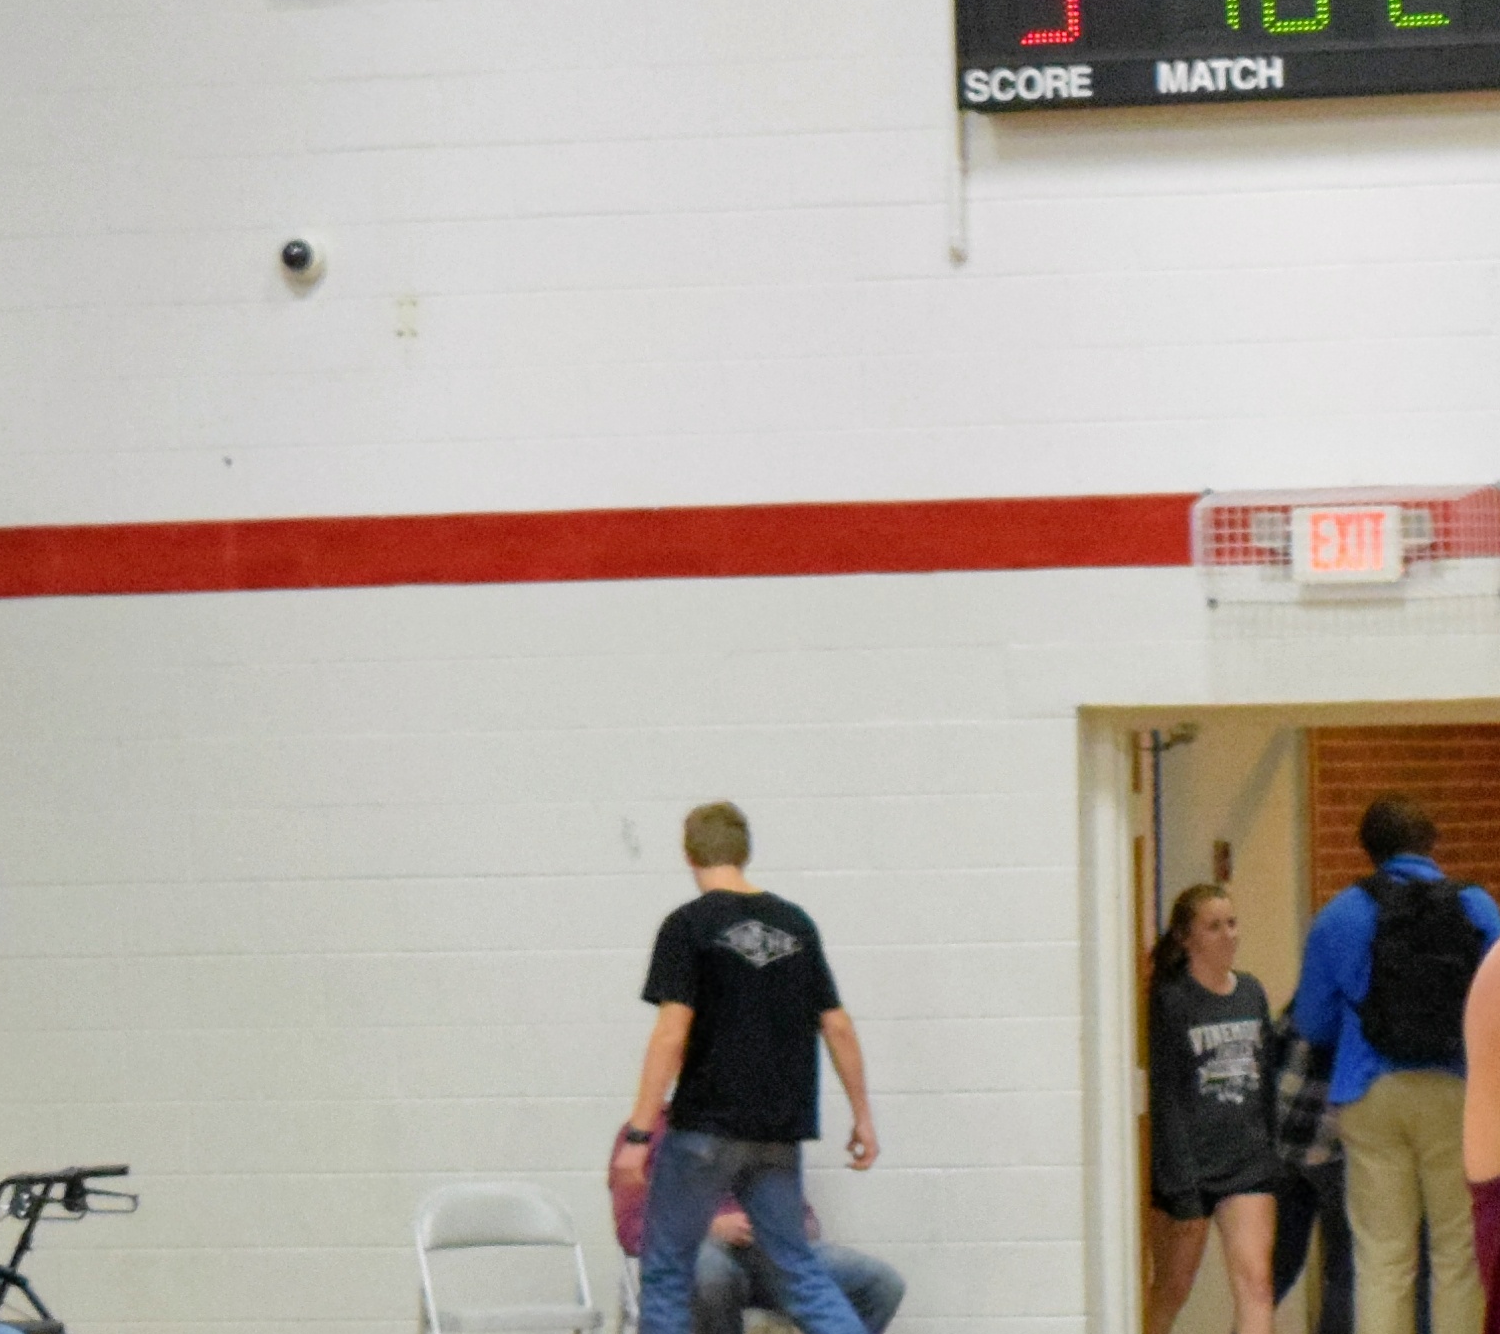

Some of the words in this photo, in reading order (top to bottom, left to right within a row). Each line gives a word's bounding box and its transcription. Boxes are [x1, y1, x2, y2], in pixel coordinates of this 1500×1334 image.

[964, 64, 1094, 104] SCORE
[1155, 56, 1285, 95] MATCH
[1308, 510, 1387, 572] EXIT
